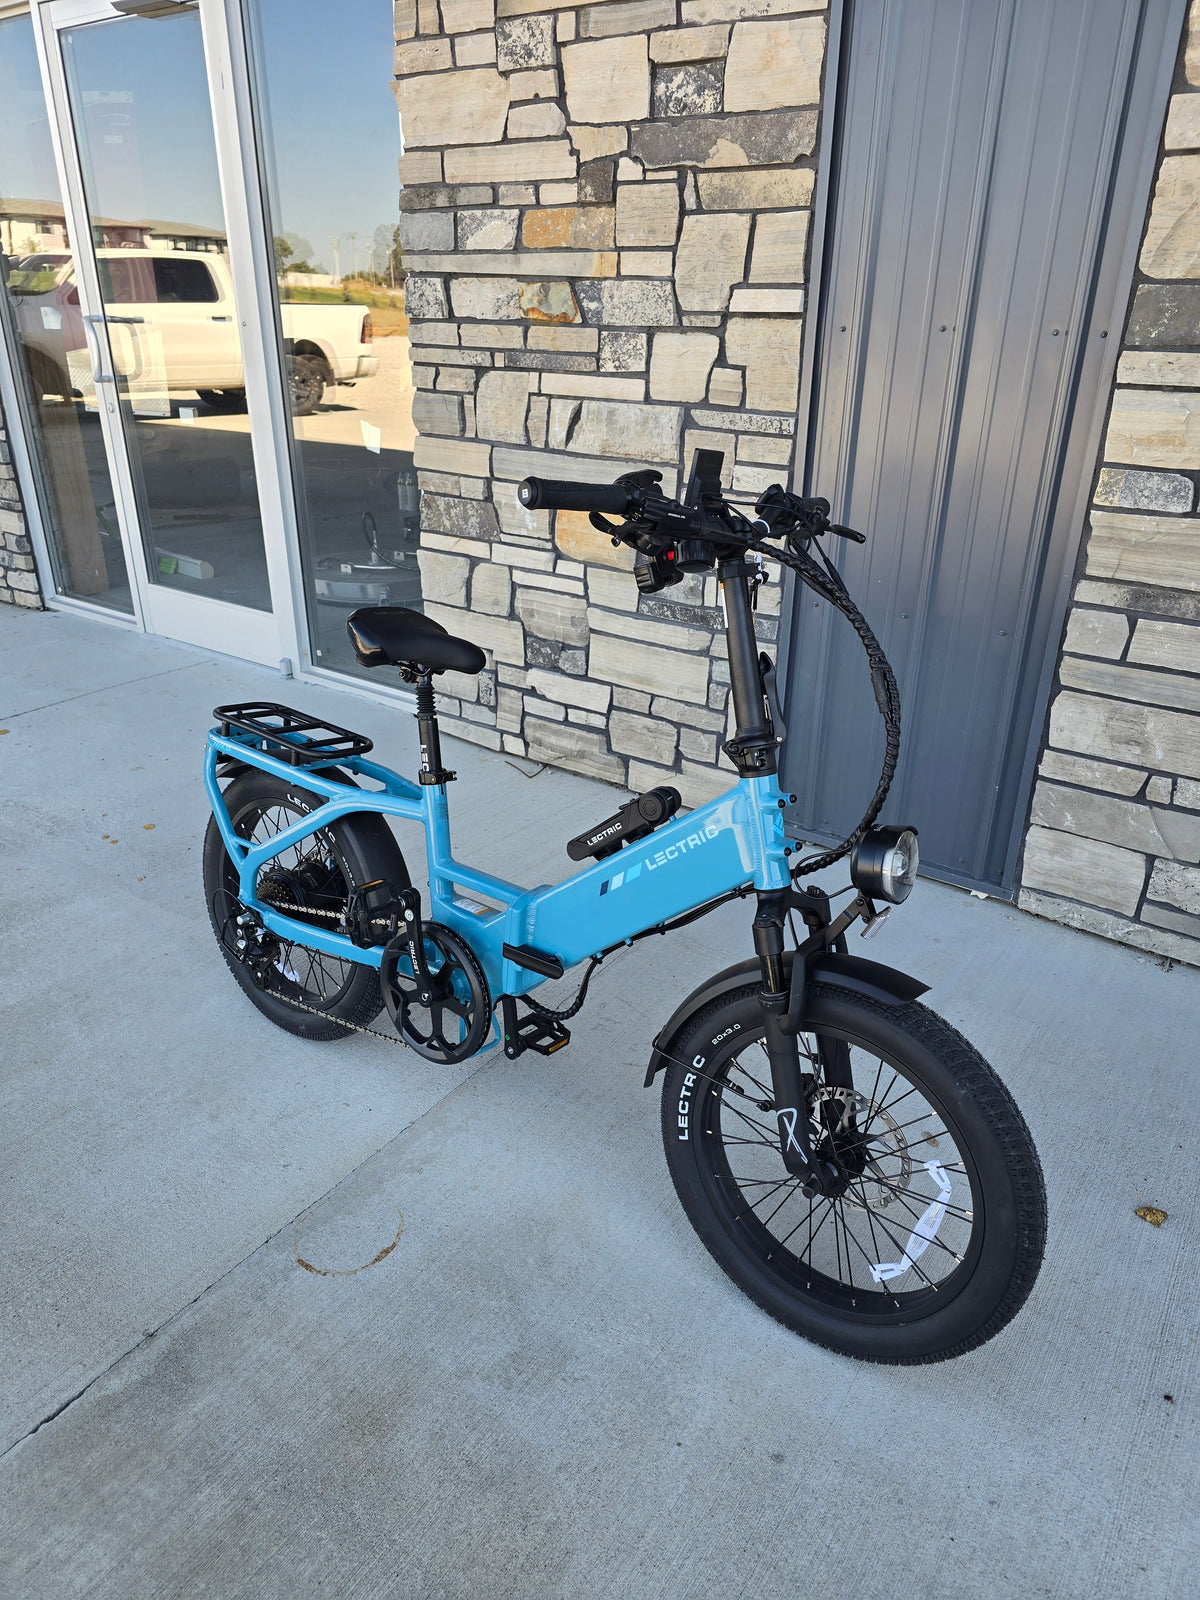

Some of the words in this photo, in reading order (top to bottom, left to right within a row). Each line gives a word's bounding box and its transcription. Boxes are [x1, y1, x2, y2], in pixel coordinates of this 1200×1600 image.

[587, 822, 622, 847] LECTRIC
[644, 824, 719, 871] LECTRIC
[409, 940, 420, 975] LECTRIC
[711, 1023, 741, 1046] 20x3.0
[678, 1054, 706, 1141] LECTRC
